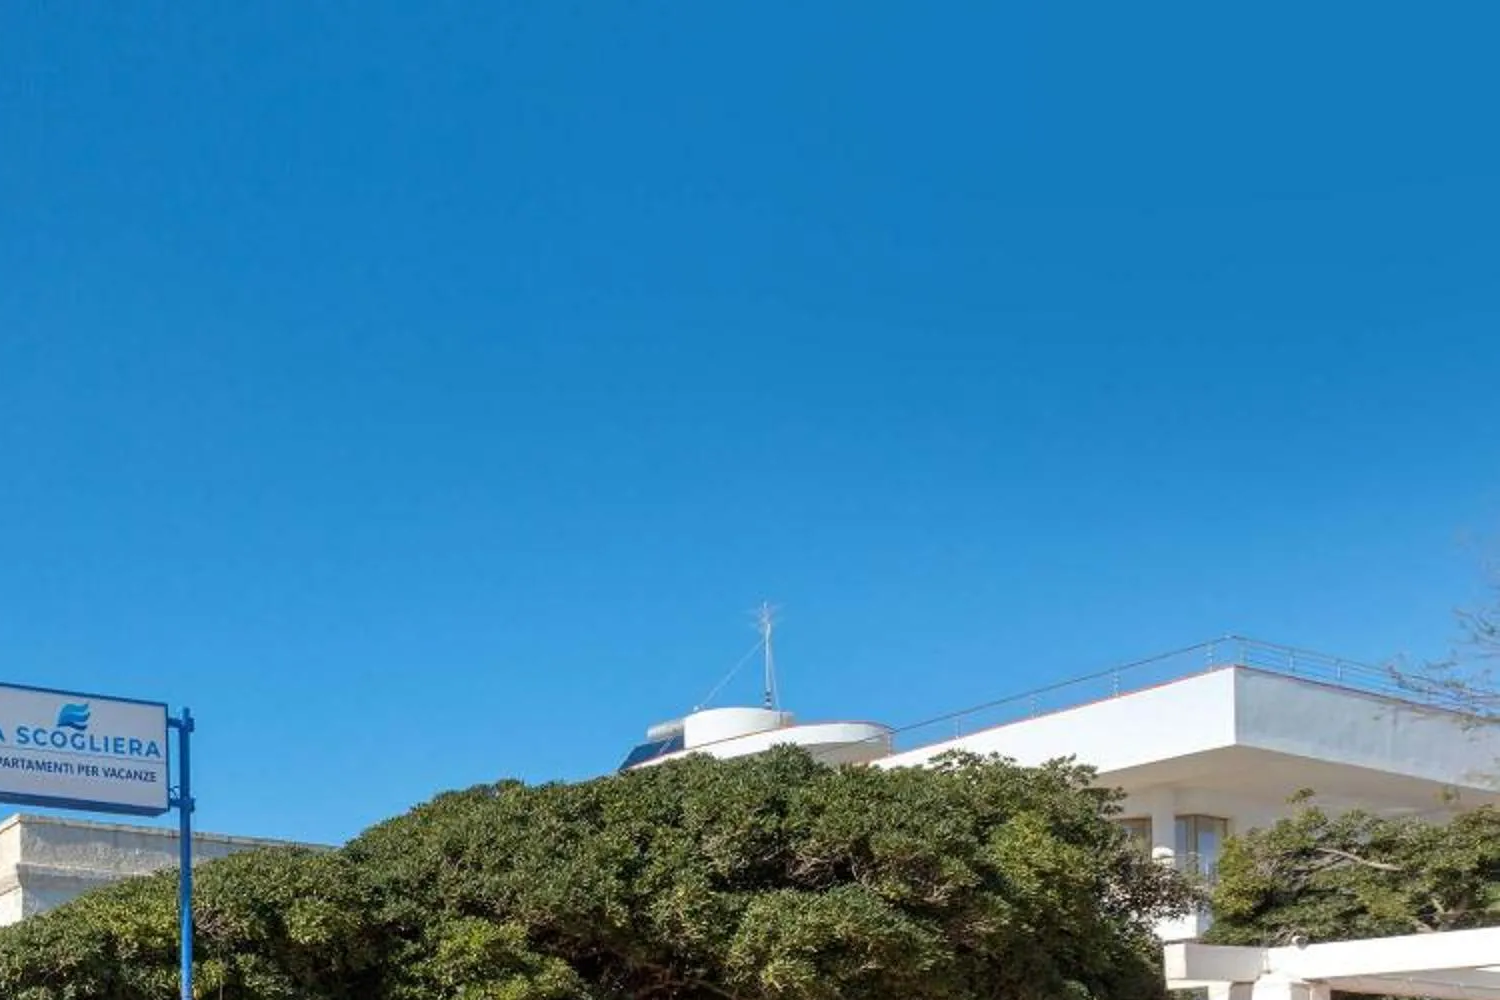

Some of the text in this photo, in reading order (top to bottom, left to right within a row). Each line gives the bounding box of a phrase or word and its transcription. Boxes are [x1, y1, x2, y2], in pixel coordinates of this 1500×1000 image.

[16, 726, 161, 758] SCOGLIERA
[77, 764, 99, 777] PER
[103, 767, 157, 783] VACANZE
